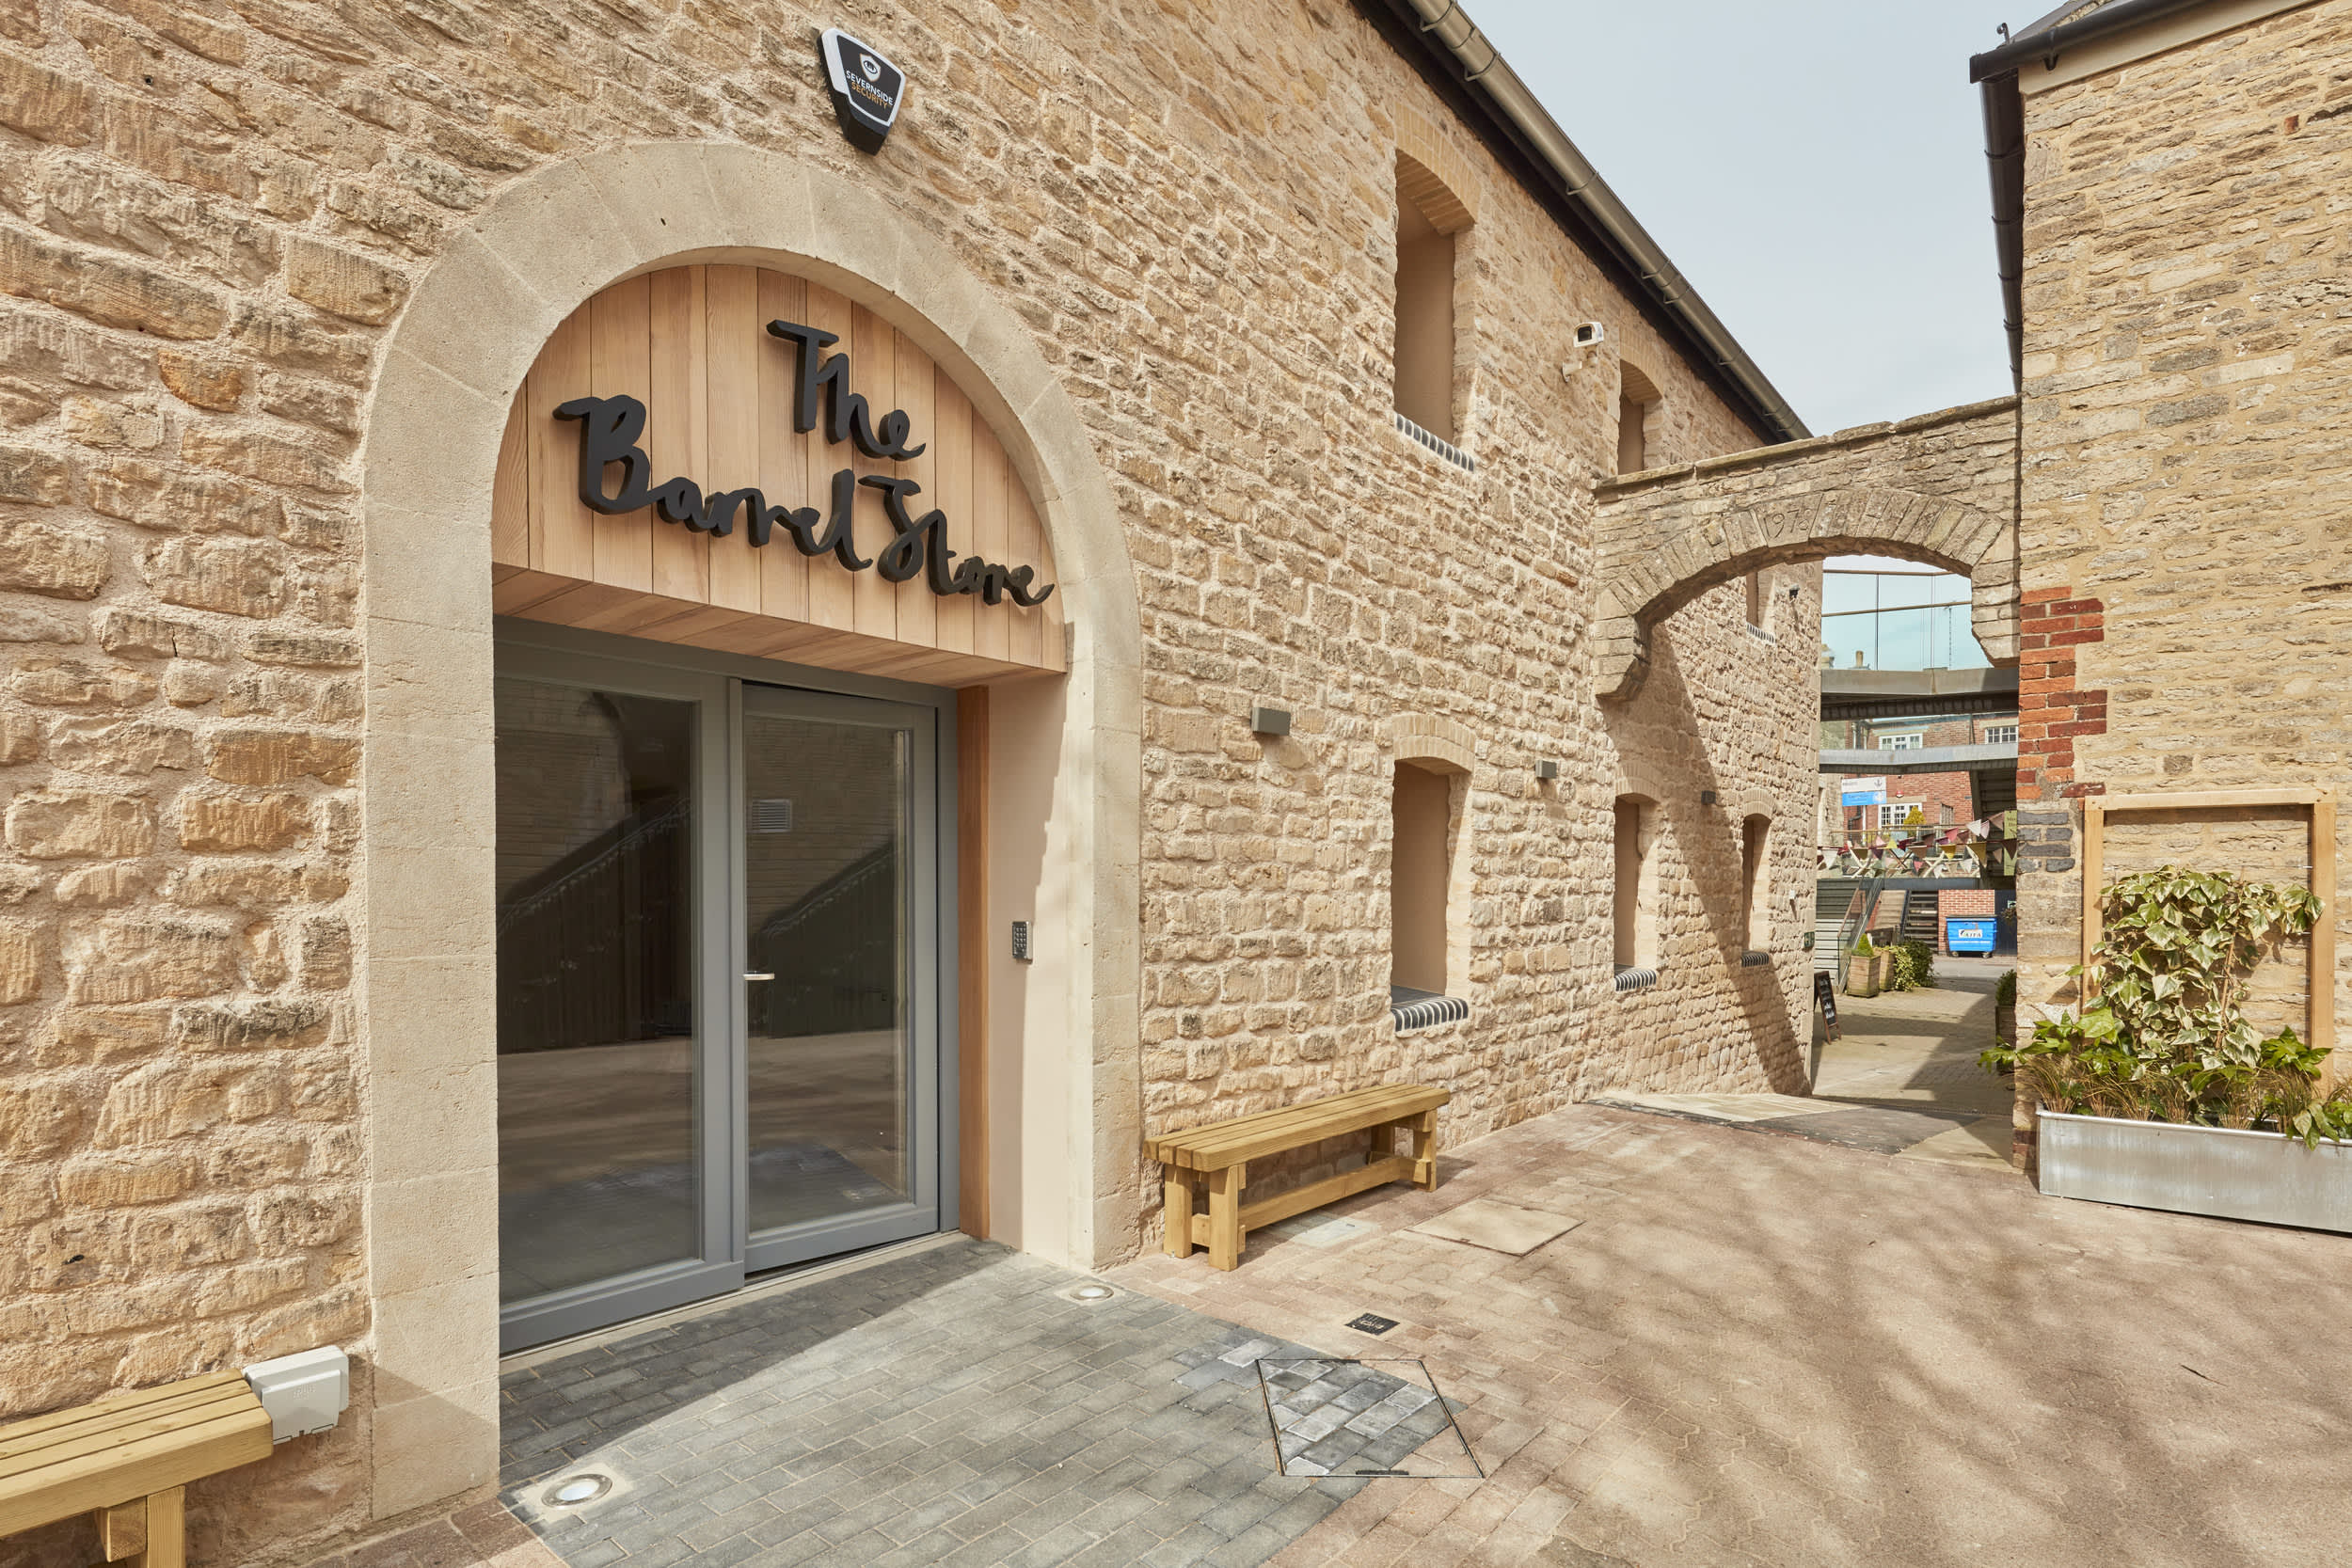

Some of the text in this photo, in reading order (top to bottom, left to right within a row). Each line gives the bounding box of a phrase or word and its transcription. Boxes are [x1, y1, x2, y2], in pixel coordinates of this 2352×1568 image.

[847, 71, 894, 106] SEVERNSIDE
[851, 82, 887, 109] SECURITY
[767, 320, 926, 461] The
[552, 394, 1055, 608] Barrel Store
